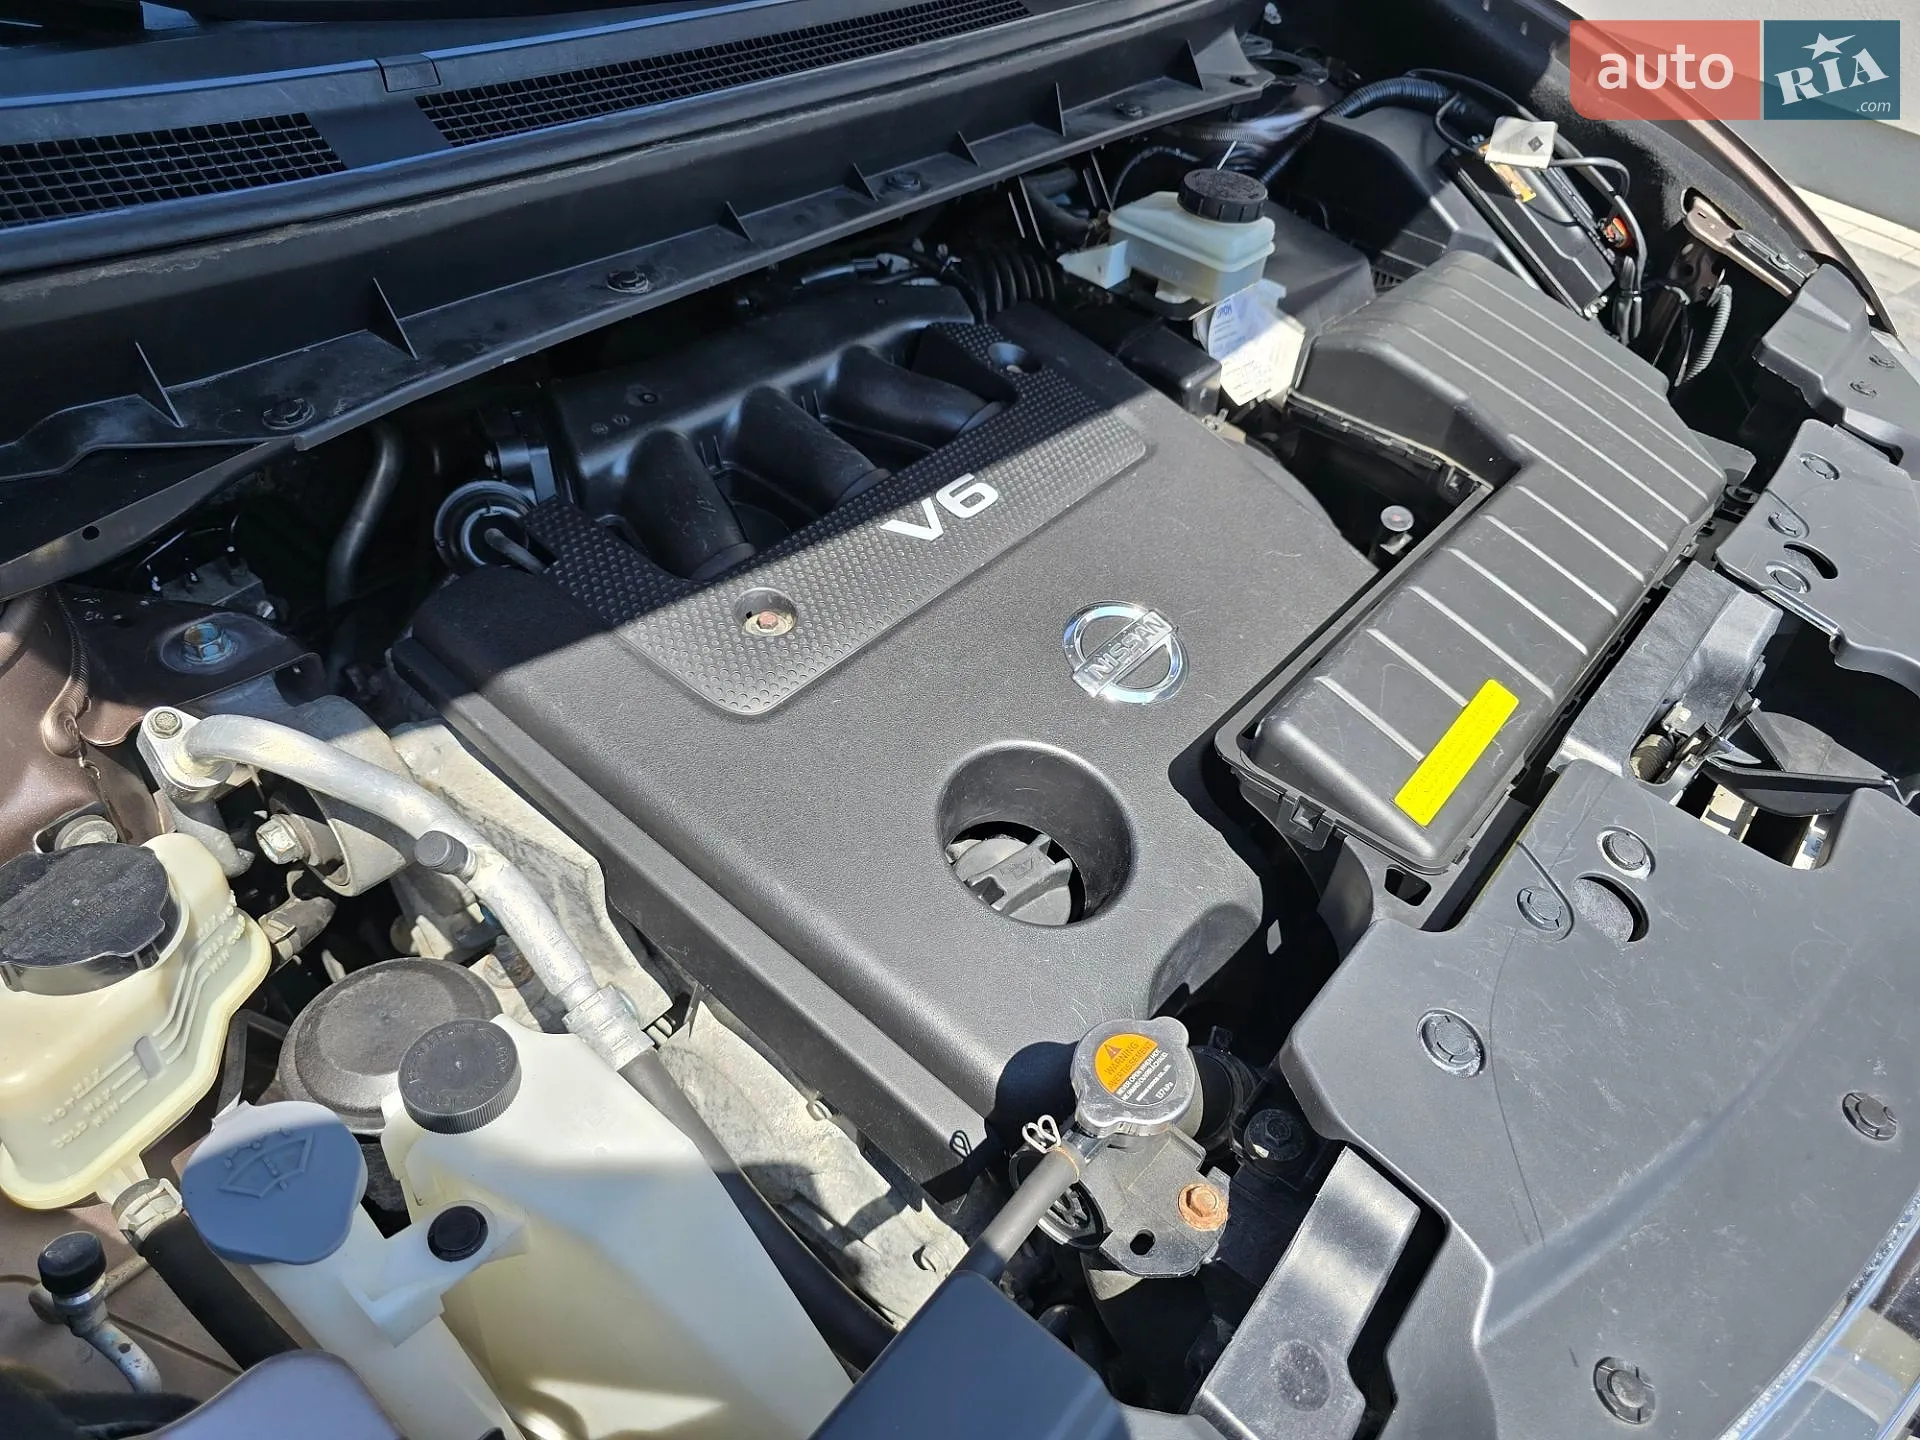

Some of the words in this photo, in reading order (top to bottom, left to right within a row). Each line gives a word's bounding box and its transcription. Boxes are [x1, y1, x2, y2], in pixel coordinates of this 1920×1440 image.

[880, 473, 999, 541] V6
[1087, 614, 1167, 679] NISSAN
[1104, 1041, 1139, 1075] WARNING
[1108, 1041, 1154, 1089] AVERTISSEMENT
[52, 1120, 88, 1149] COLD
